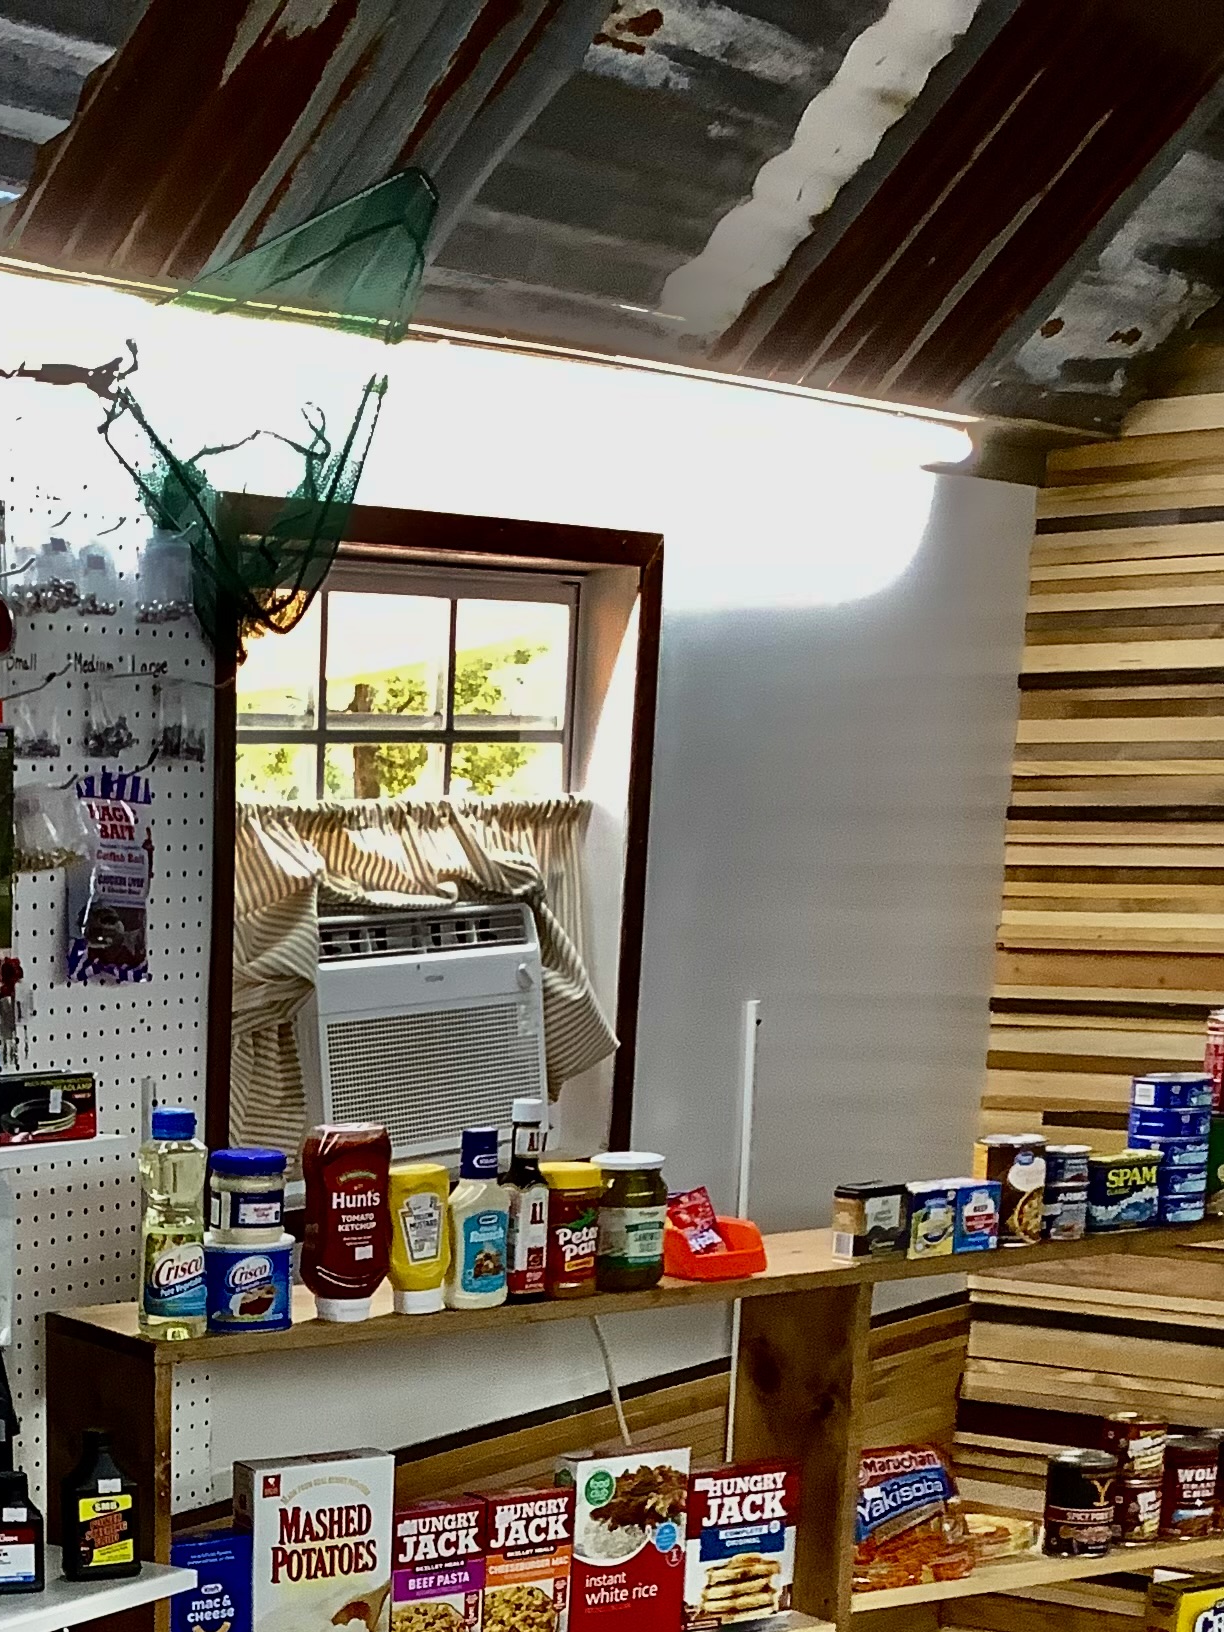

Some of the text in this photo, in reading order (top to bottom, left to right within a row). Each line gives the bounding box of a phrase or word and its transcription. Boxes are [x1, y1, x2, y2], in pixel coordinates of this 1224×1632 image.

[74, 652, 114, 674] Medium
[100, 823, 135, 840] BAIT
[1106, 1166, 1158, 1188] SPAM
[332, 1190, 381, 1210] Hunt's
[338, 1221, 377, 1232] KETCHUP
[341, 1212, 375, 1222] TOMATO
[562, 1240, 596, 1262] Pan
[154, 1254, 204, 1290] Crisco
[231, 1262, 268, 1287] Crisco
[862, 1450, 938, 1477] Maruchan
[708, 1471, 787, 1497] HUNGRY
[702, 1490, 788, 1527] JACK
[856, 1477, 945, 1523] Yakisoba
[278, 1503, 372, 1545] MASHED
[403, 1511, 480, 1537] UNGRY
[490, 1514, 570, 1548] JACK
[398, 1527, 483, 1564] JACK
[270, 1540, 377, 1584] POTATOES
[408, 1571, 470, 1591] BEEF PASTA
[585, 1571, 627, 1588] instant
[585, 1582, 659, 1606] white rice
